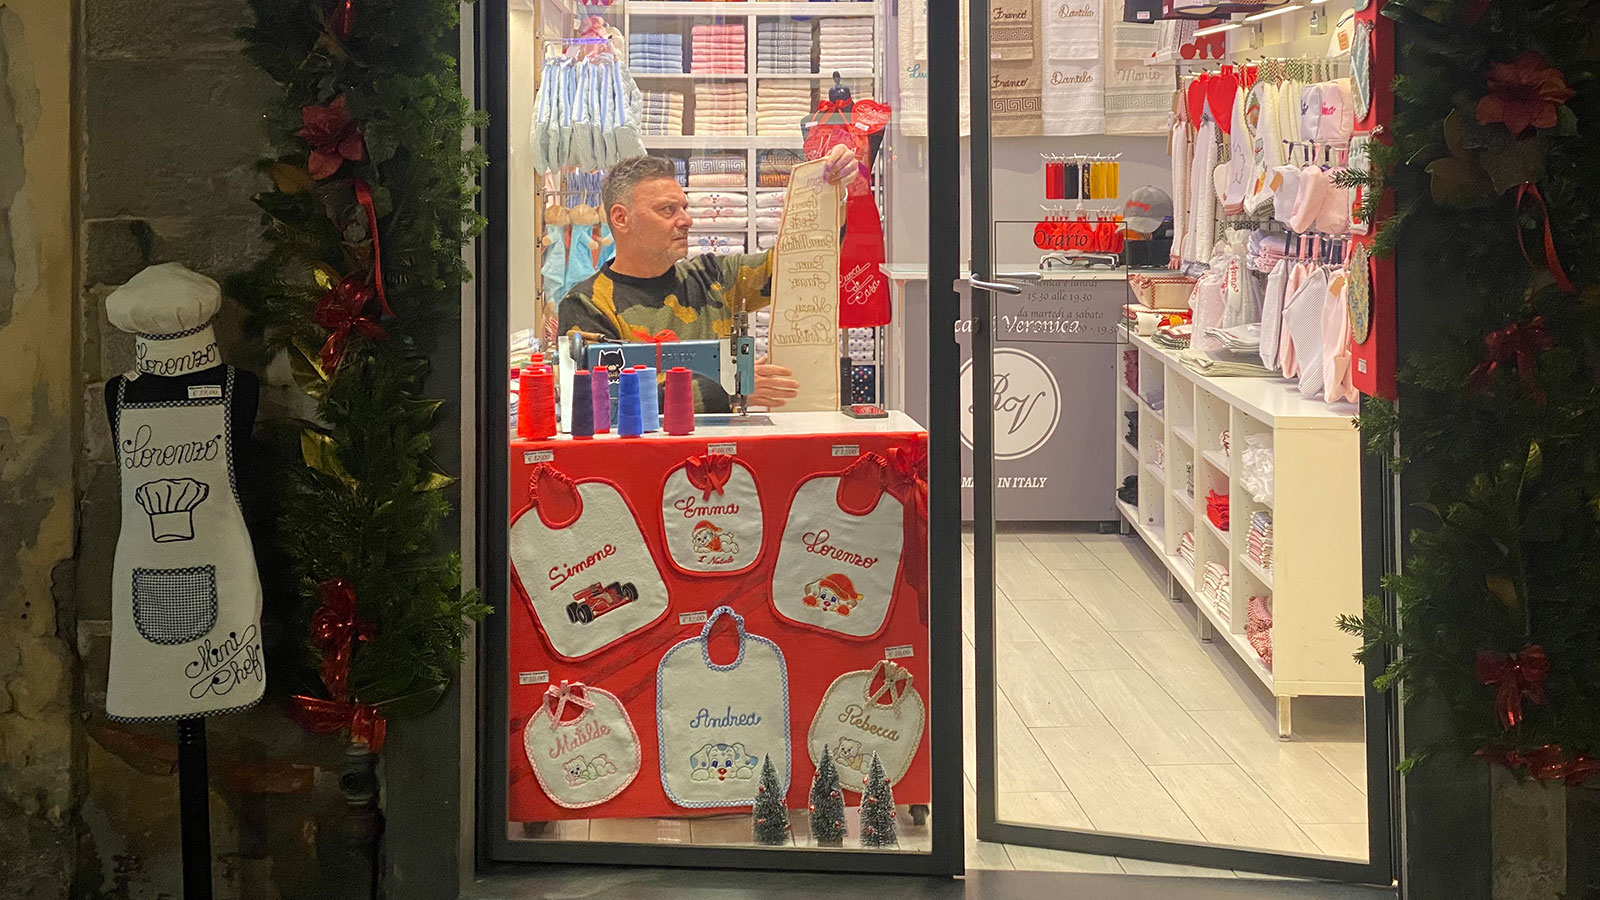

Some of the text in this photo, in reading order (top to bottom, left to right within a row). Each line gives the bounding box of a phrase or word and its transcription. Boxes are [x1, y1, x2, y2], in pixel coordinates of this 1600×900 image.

[993, 7, 1027, 19] Franco
[991, 74, 1028, 88] Franco
[1117, 67, 1164, 82] Mario
[1033, 227, 1088, 247] Orario
[1027, 290, 1092, 303] 15.30 alle 19.30
[1002, 315, 1080, 333] Veronica
[1017, 307, 1029, 318] da
[1075, 308, 1104, 319] sabato
[136, 342, 218, 375] Lorenzo
[122, 424, 222, 469] Lorenzo
[997, 477, 1047, 488] IN ITALY
[674, 496, 739, 518] Emma
[707, 555, 735, 565] Natale
[802, 529, 878, 569] Lorenzo
[548, 543, 617, 591] Simone
[185, 625, 254, 679] Mini
[203, 644, 264, 698] Chef
[689, 706, 761, 729] Andrea
[838, 704, 899, 742] Rebecca
[549, 720, 611, 759] Matilde
